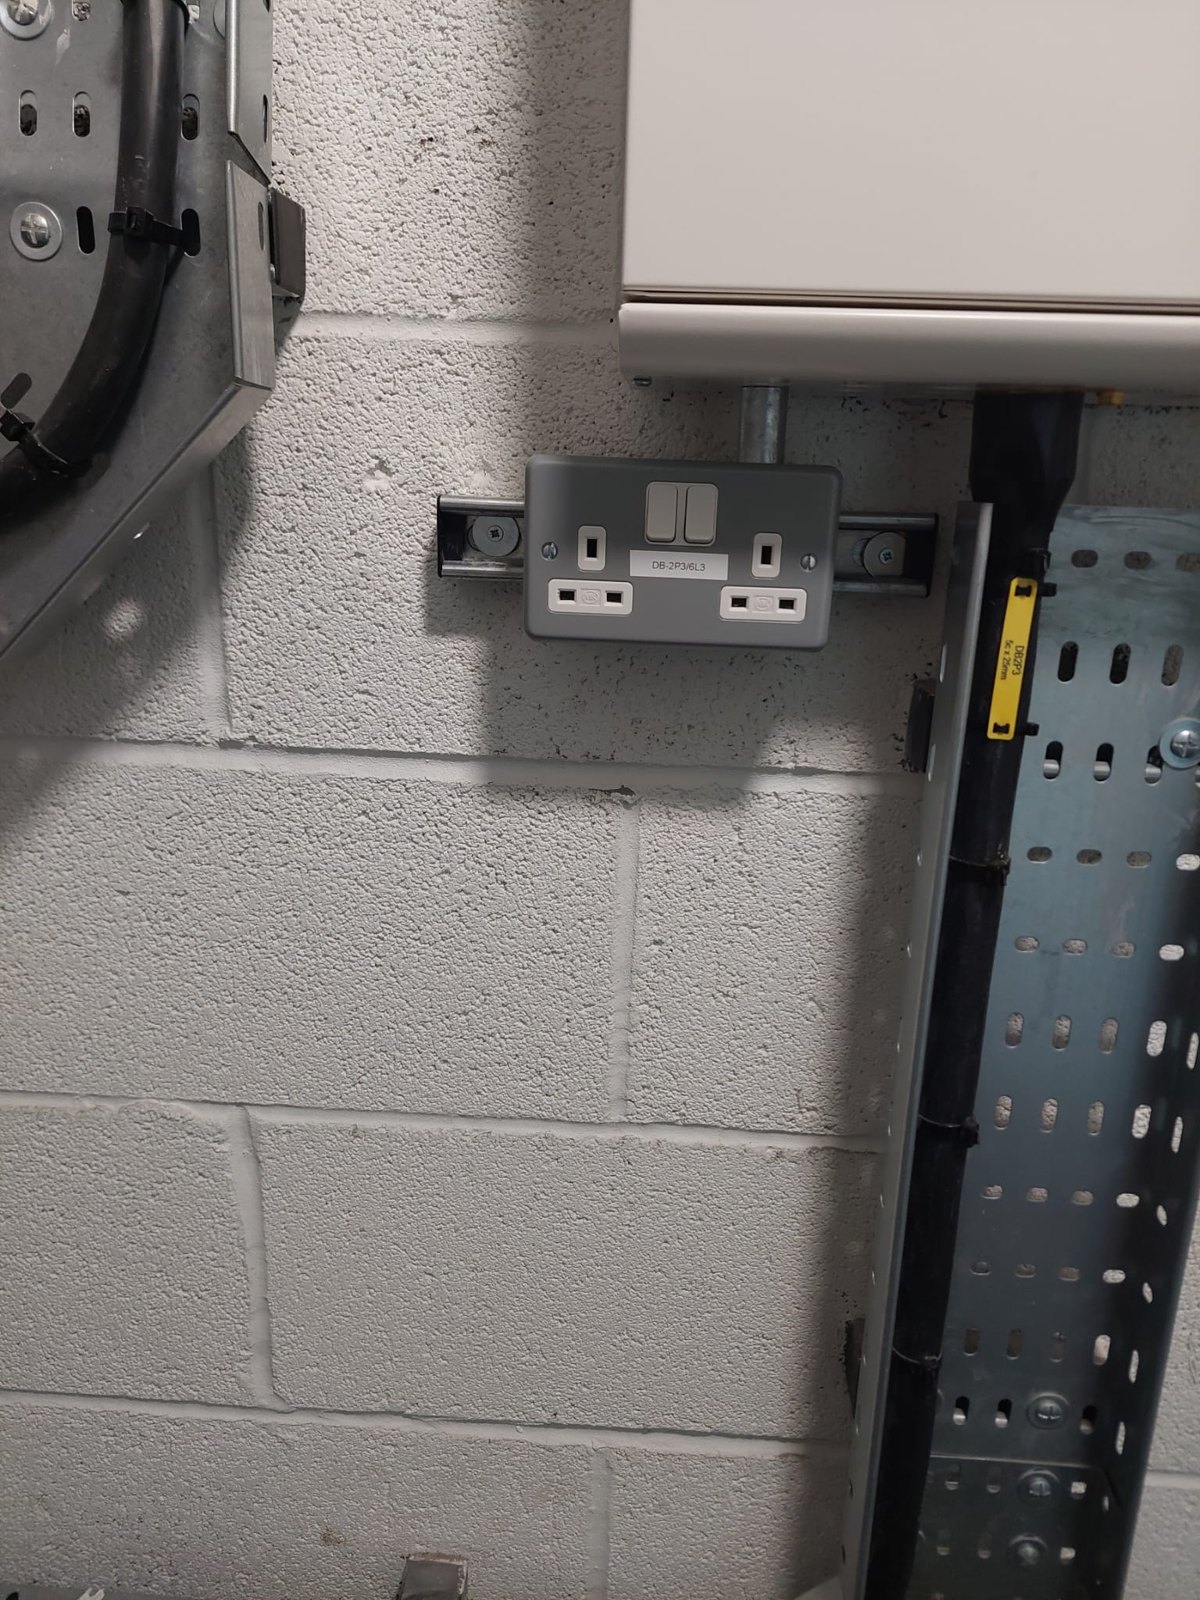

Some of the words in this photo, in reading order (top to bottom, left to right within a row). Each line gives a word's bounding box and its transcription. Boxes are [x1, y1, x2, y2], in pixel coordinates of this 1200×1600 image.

[652, 560, 706, 572] DB-2P3/6L3
[1000, 657, 1011, 681] 25mm
[1012, 645, 1025, 676] DB2P3
